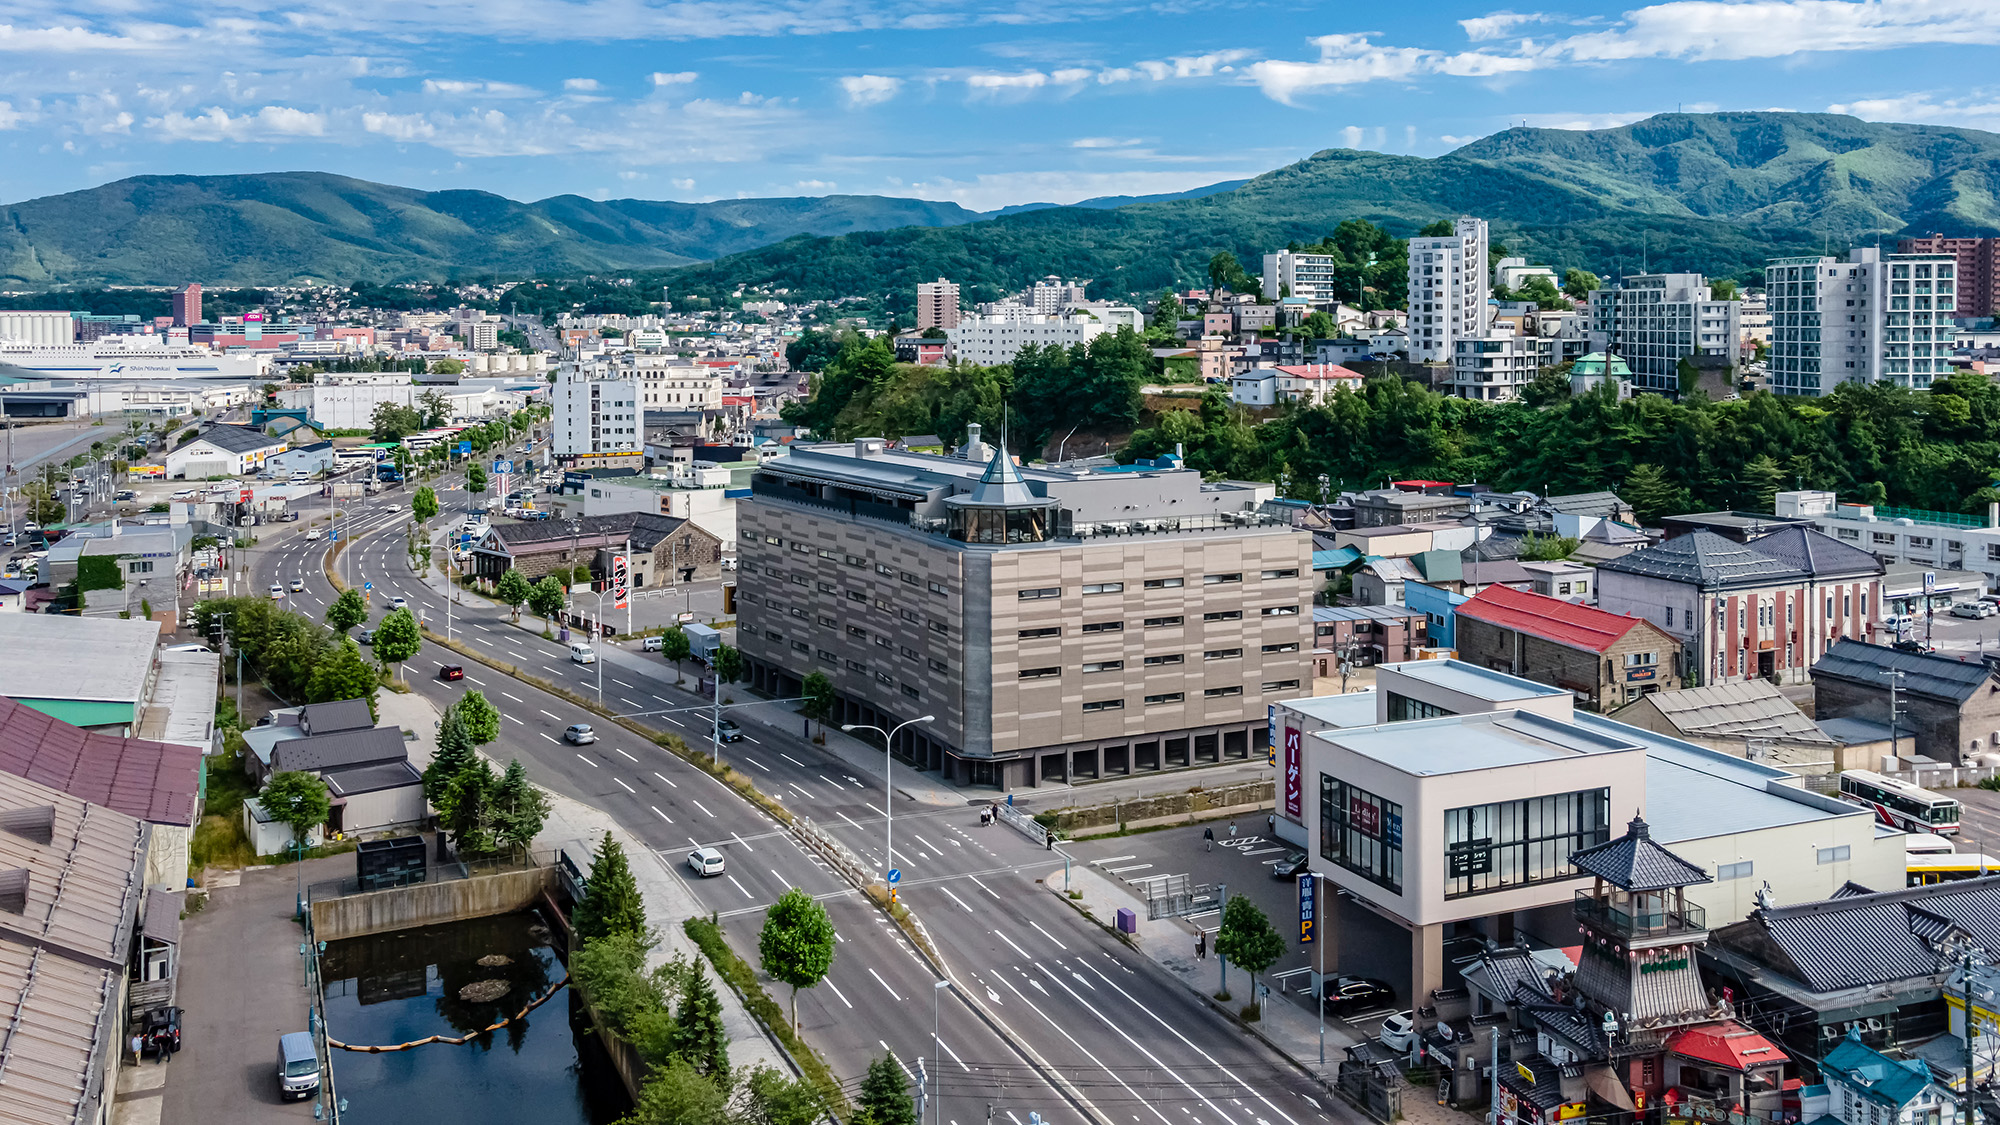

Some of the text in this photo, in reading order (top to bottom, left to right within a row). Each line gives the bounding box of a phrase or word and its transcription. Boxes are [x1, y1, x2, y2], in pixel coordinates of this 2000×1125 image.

[1287, 732, 1299, 801] バーゲン
[1301, 920, 1313, 935] P
